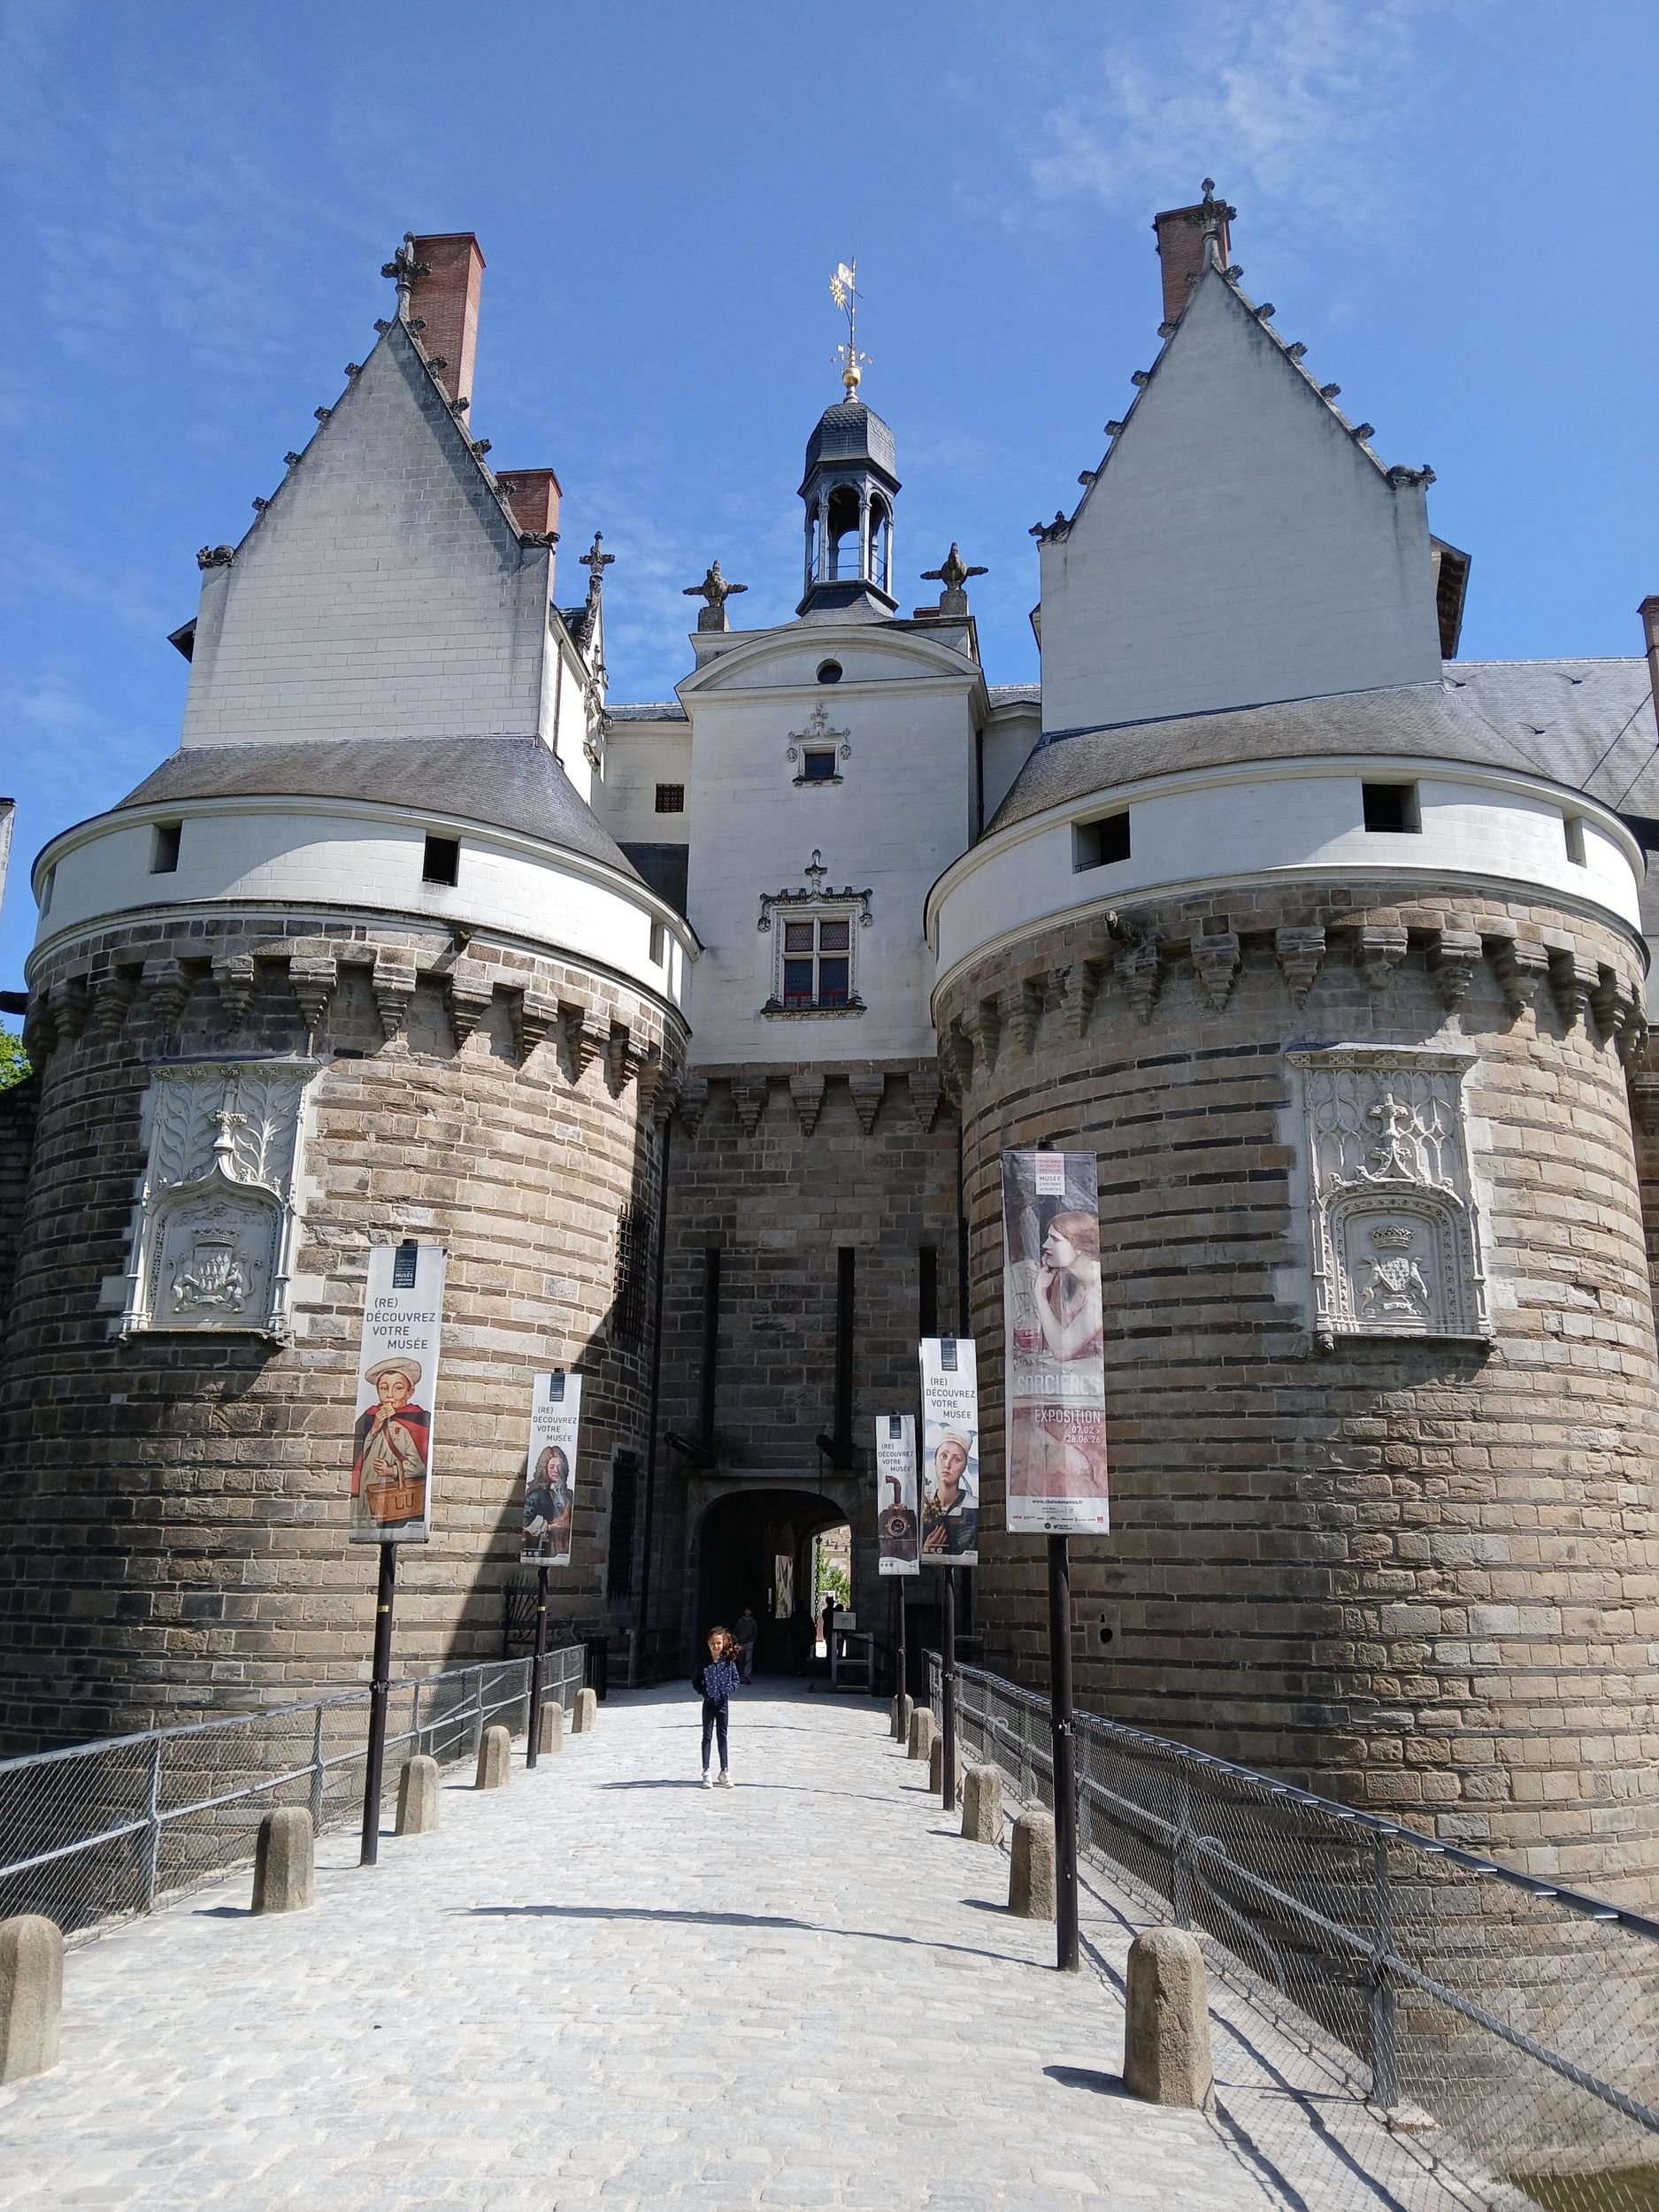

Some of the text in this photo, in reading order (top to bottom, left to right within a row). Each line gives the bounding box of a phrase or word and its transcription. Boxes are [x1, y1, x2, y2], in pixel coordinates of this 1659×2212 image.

[374, 1297, 398, 1309] (RE)
[366, 1310, 435, 1322] DÉCOUVREZ
[373, 1326, 410, 1336] VOTRE
[388, 1338, 428, 1349] MUSÉE
[930, 1377, 948, 1386] (RE)
[1017, 1370, 1101, 1395] SORCIÈRES
[926, 1387, 975, 1398] DÉCOUVREZ
[943, 1409, 972, 1418] MUSÉE
[1034, 1409, 1101, 1423] EXPOSITION
[533, 1416, 577, 1425] DÉCOUVREZ
[1071, 1425, 1094, 1434] 07.02
[1066, 1434, 1101, 1444] 28.06.26
